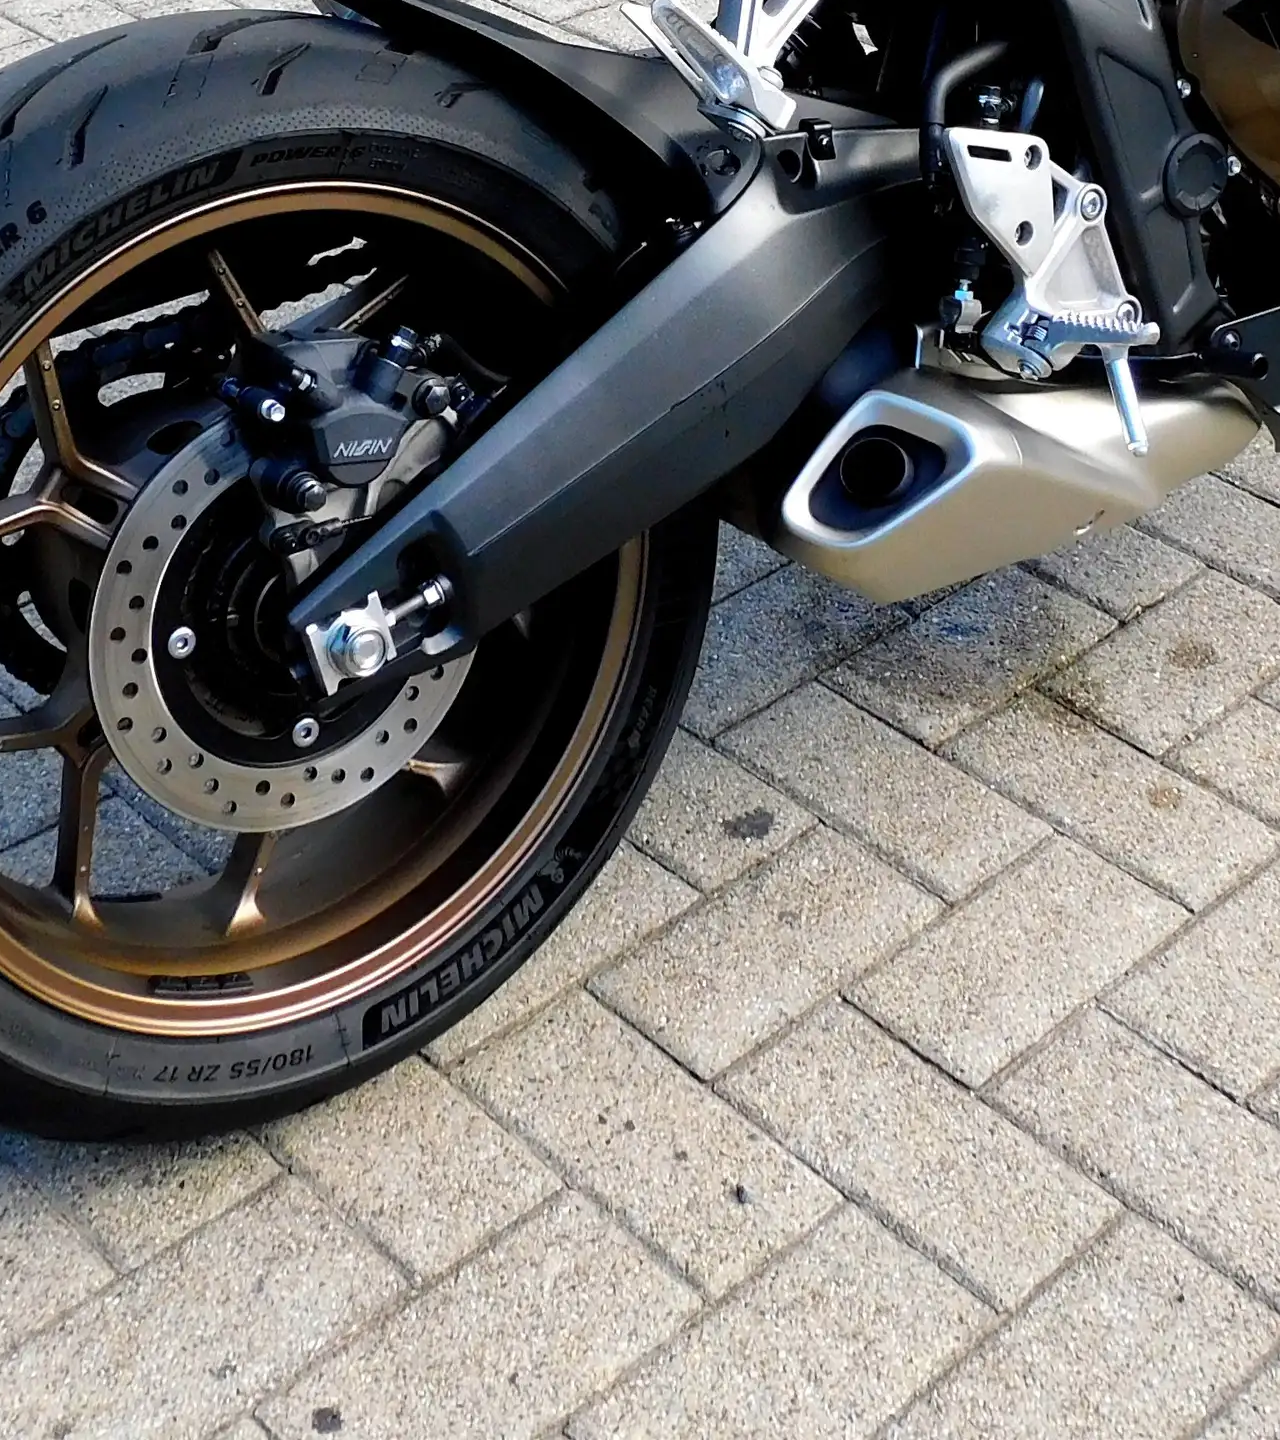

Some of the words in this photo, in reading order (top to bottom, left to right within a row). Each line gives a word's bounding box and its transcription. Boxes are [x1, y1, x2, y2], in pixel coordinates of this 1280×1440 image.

[251, 146, 341, 167] POWER
[26, 200, 48, 225] 6
[23, 162, 221, 296] MICHELIN
[381, 884, 544, 1033] MICHELIN
[152, 1064, 180, 1082] 17
[186, 1064, 220, 1082] ZR
[228, 1044, 315, 1080] 180/55
